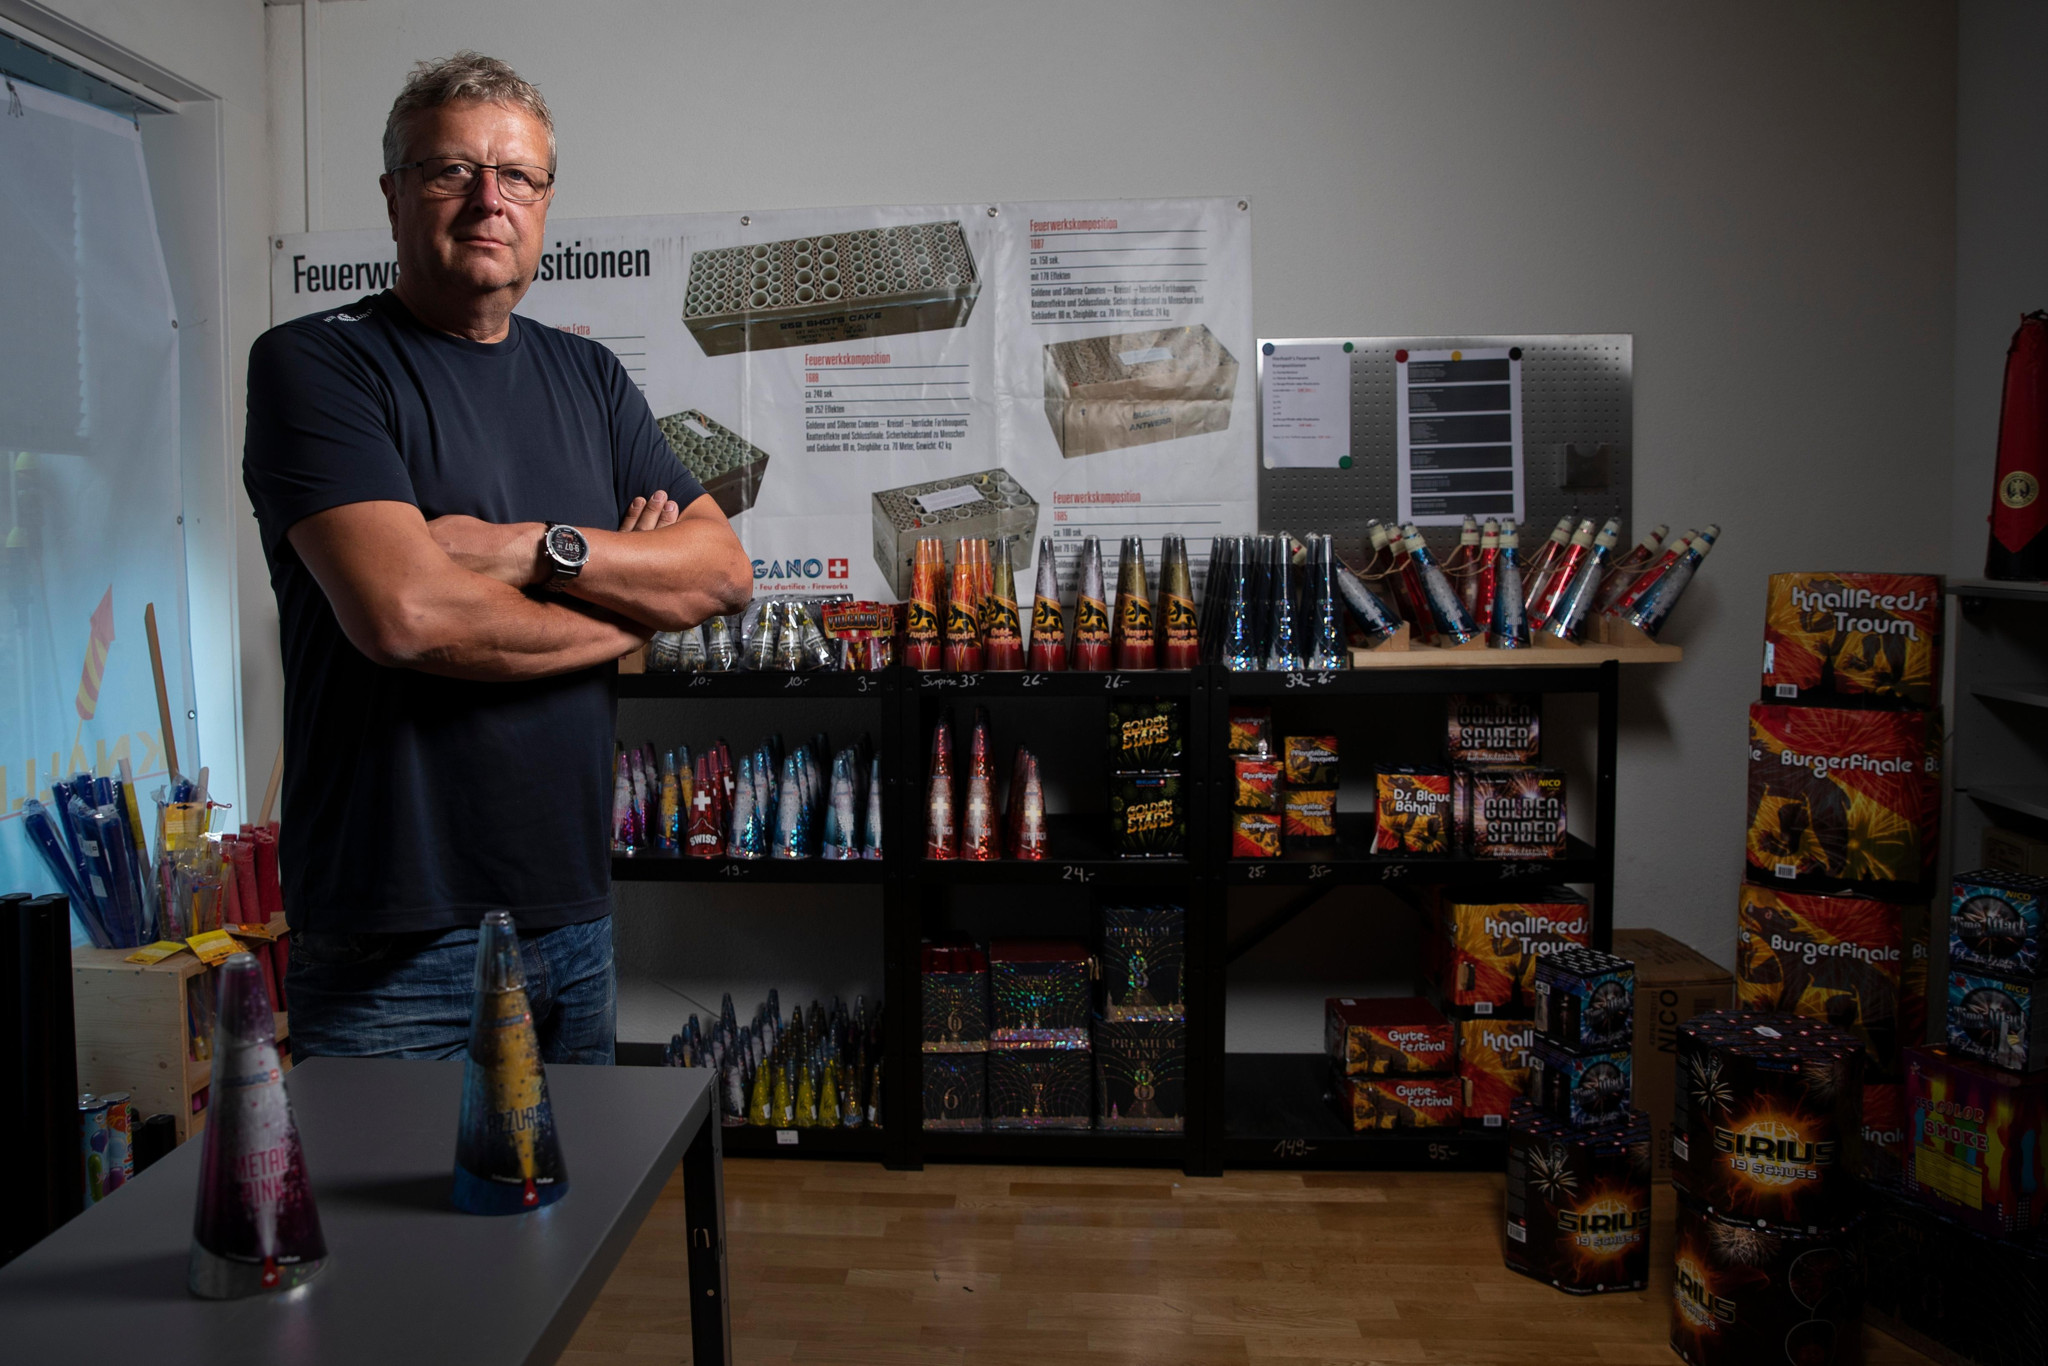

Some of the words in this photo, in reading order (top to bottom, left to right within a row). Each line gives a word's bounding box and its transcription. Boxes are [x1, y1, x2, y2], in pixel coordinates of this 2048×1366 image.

[1030, 218, 1117, 231] Feuerwerkskomposition
[532, 241, 650, 282] sitionen
[1050, 270, 1070, 279] Effekten
[1053, 287, 1061, 296] und
[1067, 298, 1077, 307] und
[806, 316, 845, 327] SHOTS
[848, 312, 882, 322] CAKE
[573, 323, 591, 335] Extra
[805, 352, 891, 366] Feuerwerkskomposition
[825, 404, 845, 413] Effekten
[827, 420, 835, 429] und
[842, 431, 850, 440] und
[940, 428, 965, 439] Menschen
[806, 443, 815, 453] und
[1053, 491, 1141, 505] Feuerwerkskomposition
[752, 558, 824, 578] GANO
[760, 582, 773, 591] Feu
[775, 581, 806, 591] d'artifice
[812, 582, 849, 591] Fireworks
[1791, 586, 1929, 612] Knallfreds
[1833, 611, 1919, 641] Troum
[1458, 704, 1531, 725] GOLDEN
[1460, 727, 1529, 750] SPIDER
[1781, 750, 1914, 779] Burgerfinale
[1538, 779, 1561, 787] NICO
[1393, 788, 1412, 801] Ds
[1395, 800, 1436, 817] Bähnli
[1485, 798, 1560, 820] GOLDEN
[1487, 821, 1557, 844] SPIDER
[689, 833, 718, 847] SWISS
[2005, 888, 2031, 902] NICO
[1105, 926, 1170, 938] PREMIUM
[1484, 916, 1590, 939] Knallfreds
[1121, 937, 1153, 948] LINE
[1770, 934, 1901, 965] Burgerfinale
[2004, 982, 2030, 996] NICO
[1657, 989, 1678, 1054] NICO
[1110, 1038, 1176, 1049] PREMIUM
[1387, 1030, 1430, 1043] Gurte-
[1483, 1030, 1535, 1054] Knall
[1400, 1040, 1445, 1053] Festival
[1127, 1048, 1160, 1060] LINE
[1395, 1084, 1437, 1097] Gurte-
[1406, 1095, 1453, 1107] Festival
[1935, 1099, 1985, 1125] COLOR
[1923, 1118, 1990, 1152] SMOKE
[1712, 1125, 1838, 1166] SIRIUS
[1730, 1158, 1747, 1171] 19
[1751, 1162, 1818, 1180] SCHUSS
[1557, 1206, 1651, 1234] SIRIUS
[1575, 1235, 1590, 1247] 19
[1593, 1234, 1641, 1247] SCHUSS
